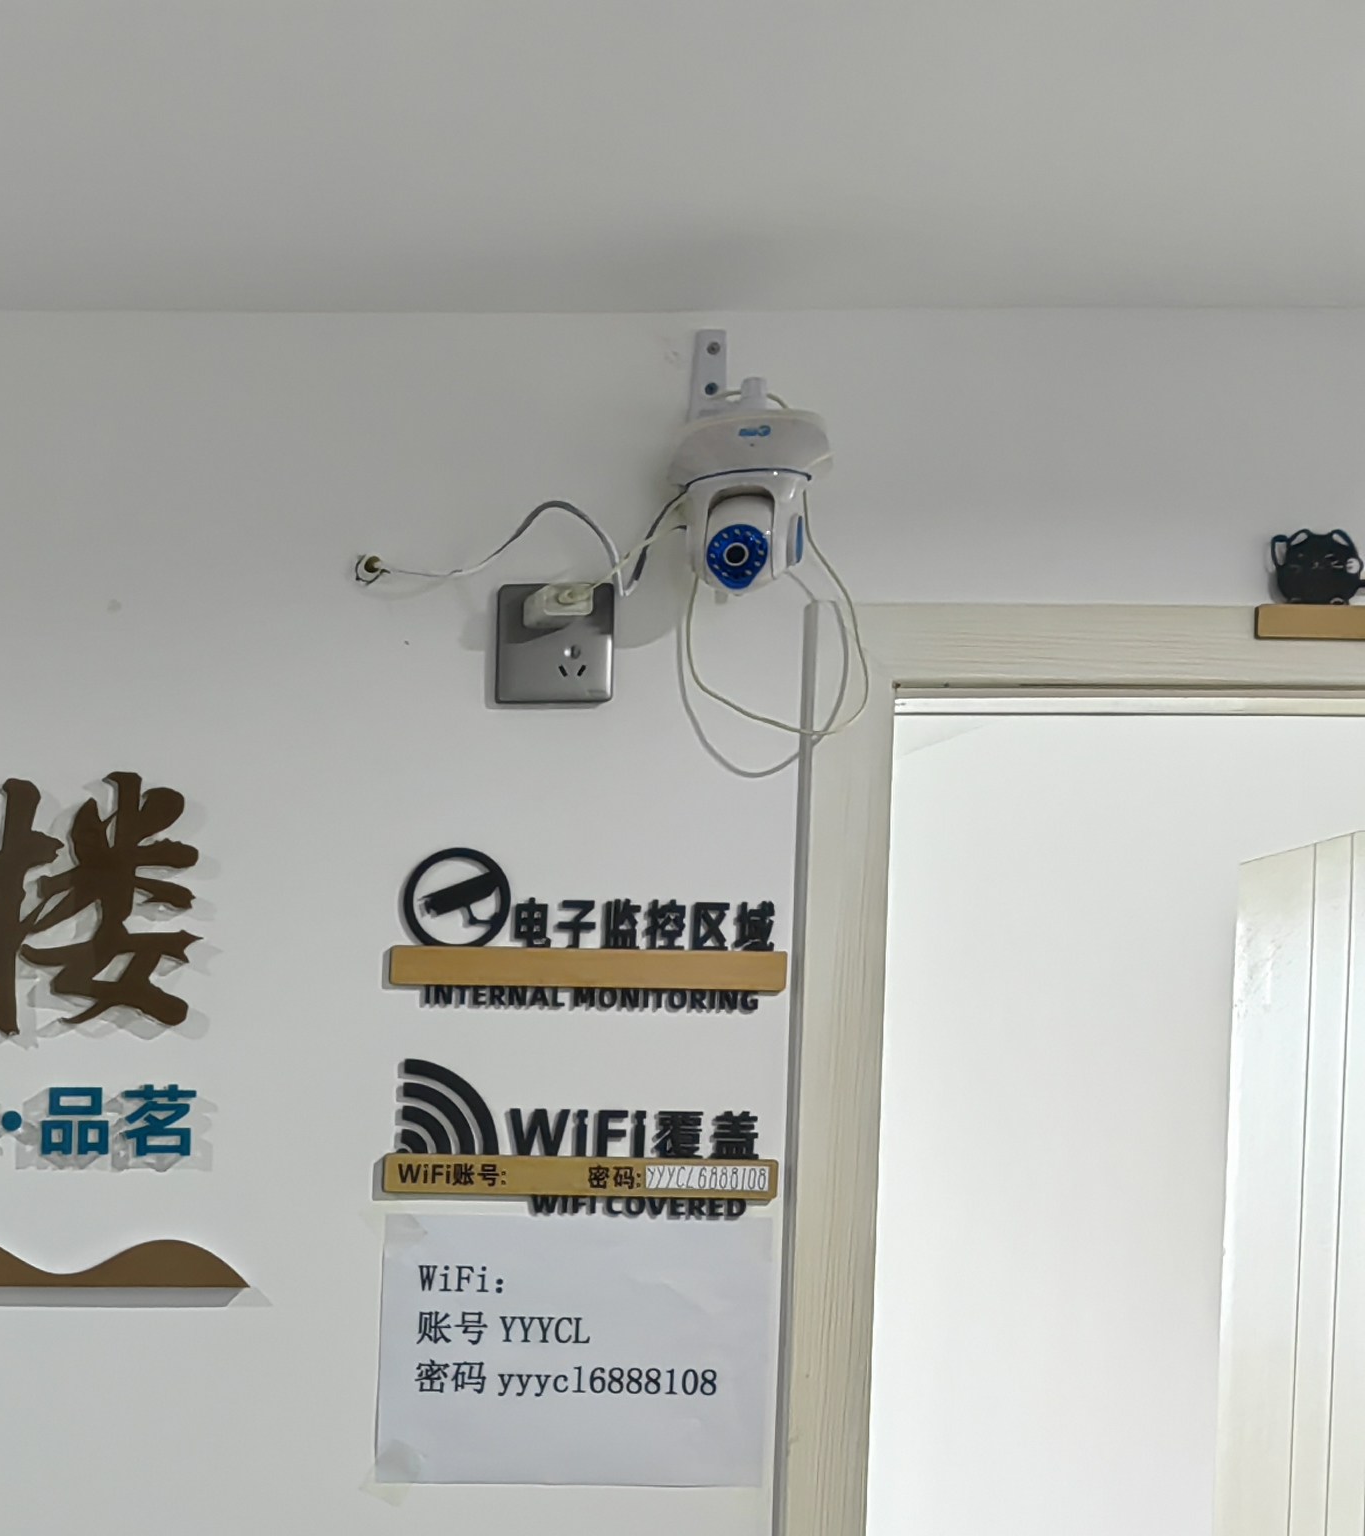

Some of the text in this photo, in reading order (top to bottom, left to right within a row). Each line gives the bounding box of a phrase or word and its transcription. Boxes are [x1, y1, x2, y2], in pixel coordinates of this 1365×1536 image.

[513, 897, 776, 952] 电子监控区域
[421, 984, 759, 1011] INTERNAL MONITORING
[510, 1108, 760, 1161] WiFi覆盖
[610, 1197, 747, 1220] COVERED
[416, 1311, 591, 1345] 账号 YYYCL
[414, 1359, 719, 1397] 密码 yyycl6888108
